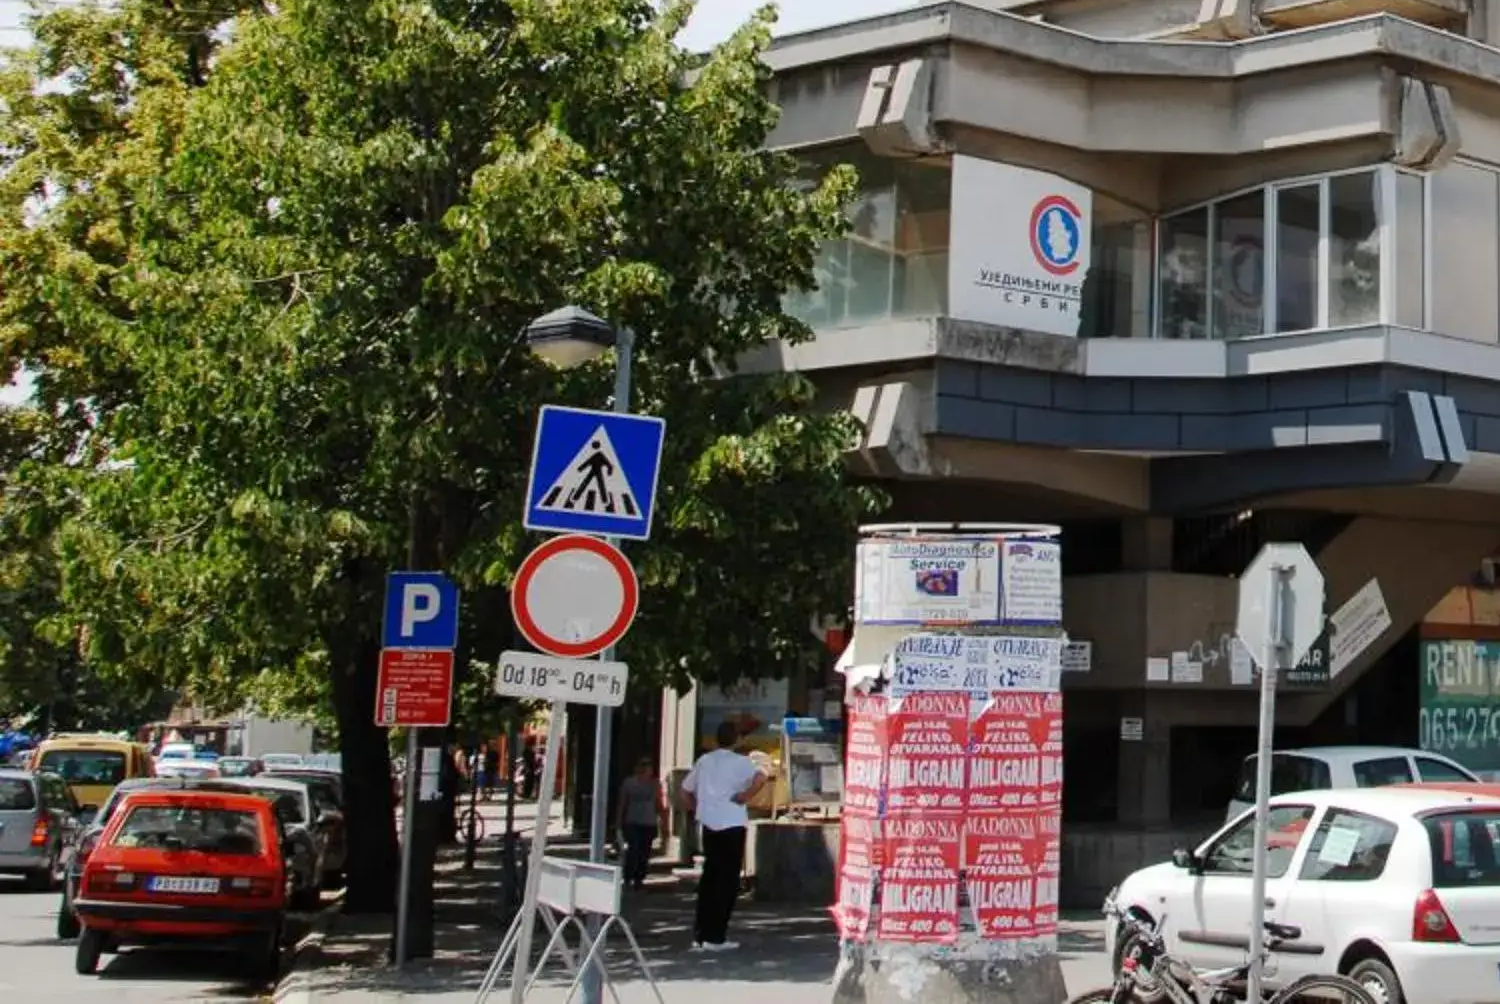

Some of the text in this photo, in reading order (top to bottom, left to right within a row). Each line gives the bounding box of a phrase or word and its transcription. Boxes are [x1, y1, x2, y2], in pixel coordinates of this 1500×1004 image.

[910, 558, 966, 570] Service
[401, 583, 441, 637] P
[503, 664, 525, 685] Od
[1426, 643, 1487, 686] RENT
[903, 696, 966, 716] ADONNA
[888, 757, 965, 789] MILIGRAM
[969, 757, 1039, 788] MILIGRAM
[884, 819, 957, 840] MADONNA
[966, 816, 1034, 838] MADONNA
[881, 881, 957, 913] MILIGRAM
